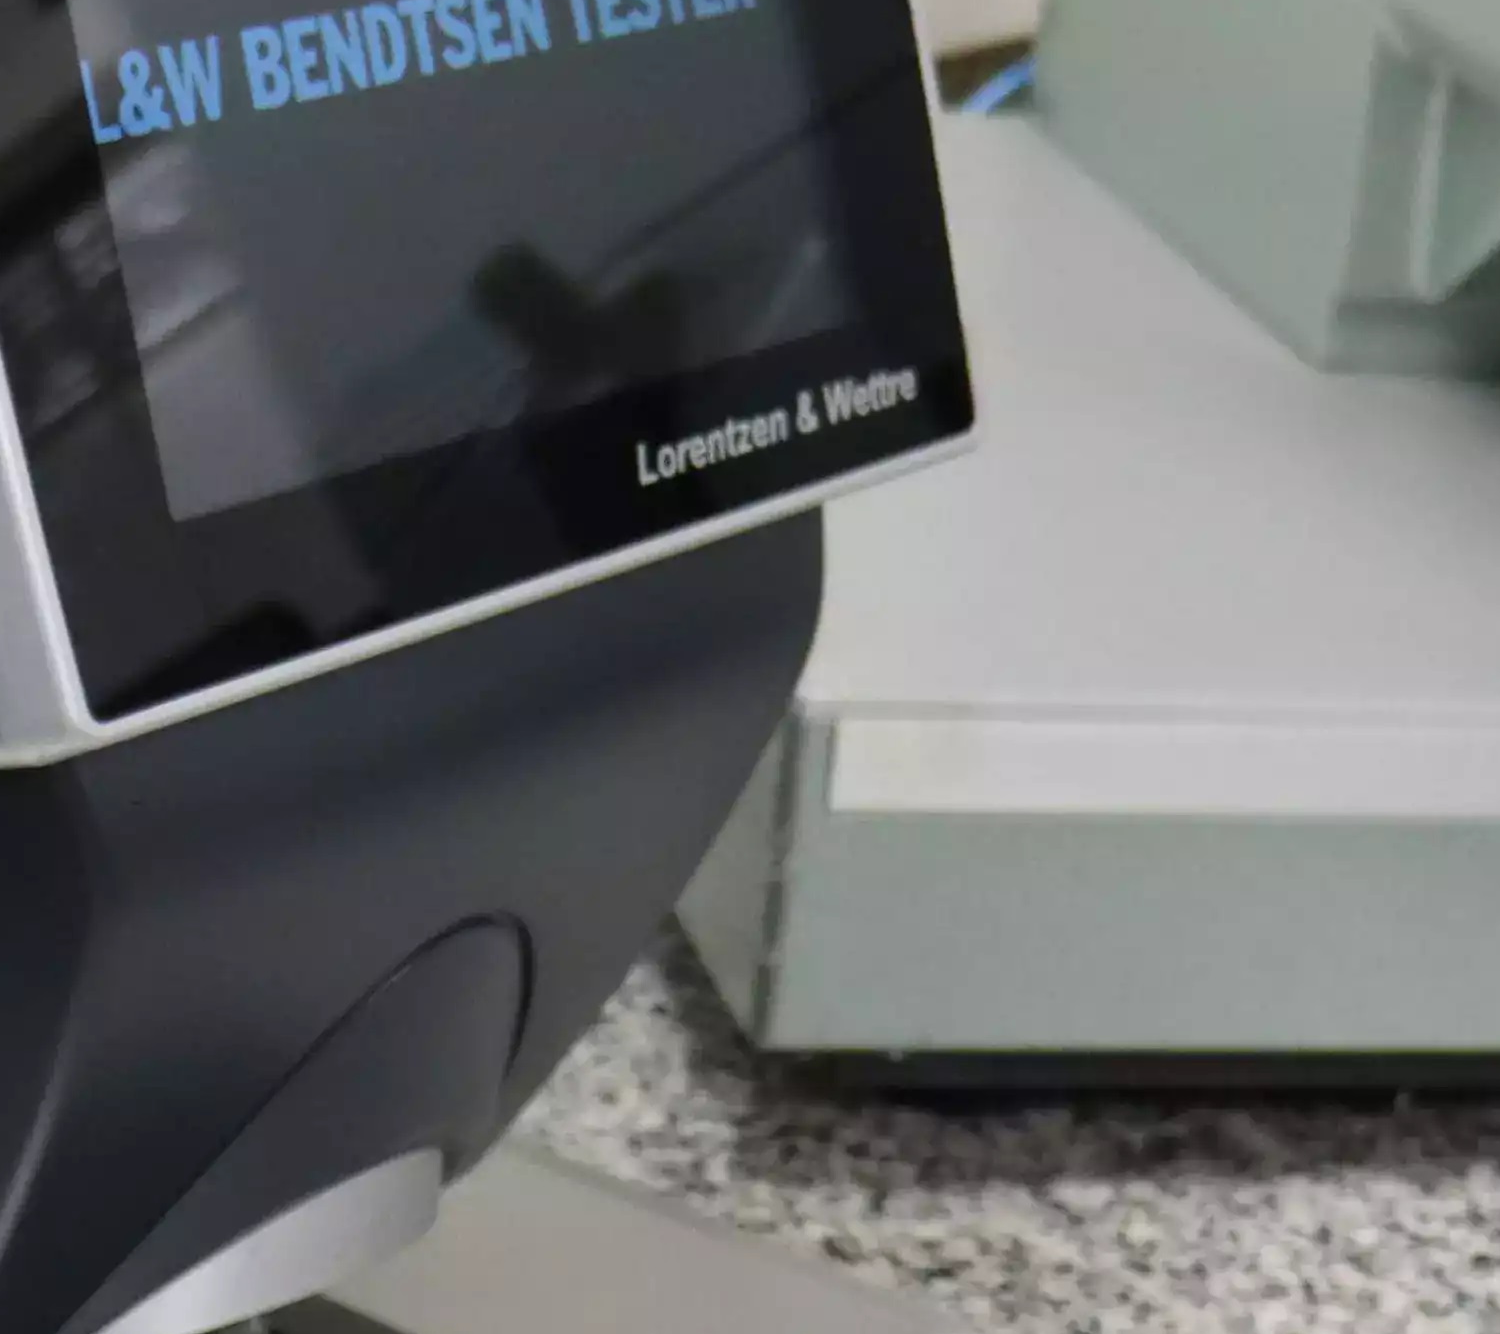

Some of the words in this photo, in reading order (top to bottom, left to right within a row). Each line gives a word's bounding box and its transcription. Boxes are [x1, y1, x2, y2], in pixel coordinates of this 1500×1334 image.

[80, 35, 222, 145] L&W
[636, 408, 788, 486] Lorentzen
[796, 389, 819, 433] &
[822, 368, 918, 424] Wettre
